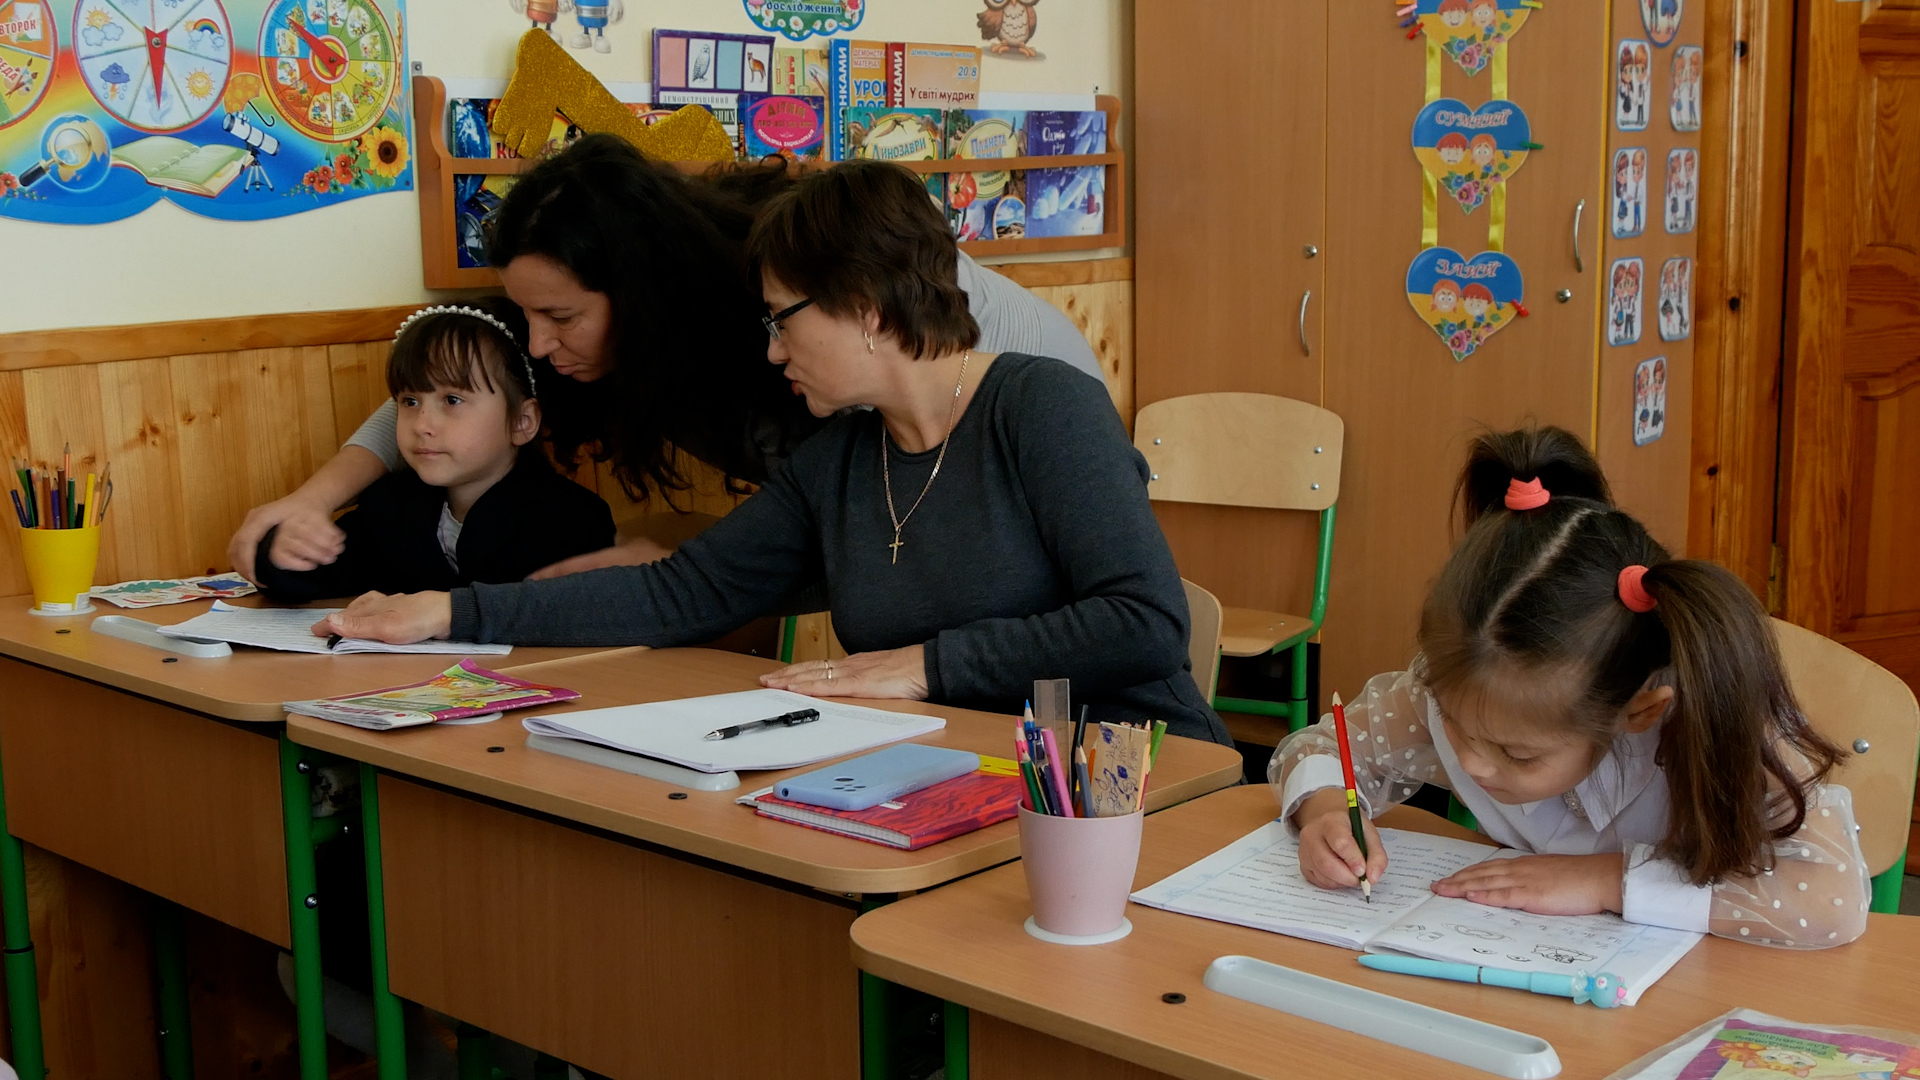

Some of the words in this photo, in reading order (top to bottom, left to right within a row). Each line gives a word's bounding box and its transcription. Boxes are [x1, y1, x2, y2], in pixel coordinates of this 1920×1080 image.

[766, 1, 841, 14] дослідження
[0, 57, 18, 81] ЕДА
[893, 51, 903, 108] НКАМИ
[910, 87, 917, 99] У
[918, 87, 938, 99] світі
[939, 92, 975, 103] мудрих
[1435, 109, 1513, 129] СУМНИЙ
[970, 134, 1007, 157] ПЛАНЕТА
[1435, 259, 1502, 279] ЗЛИЙ
